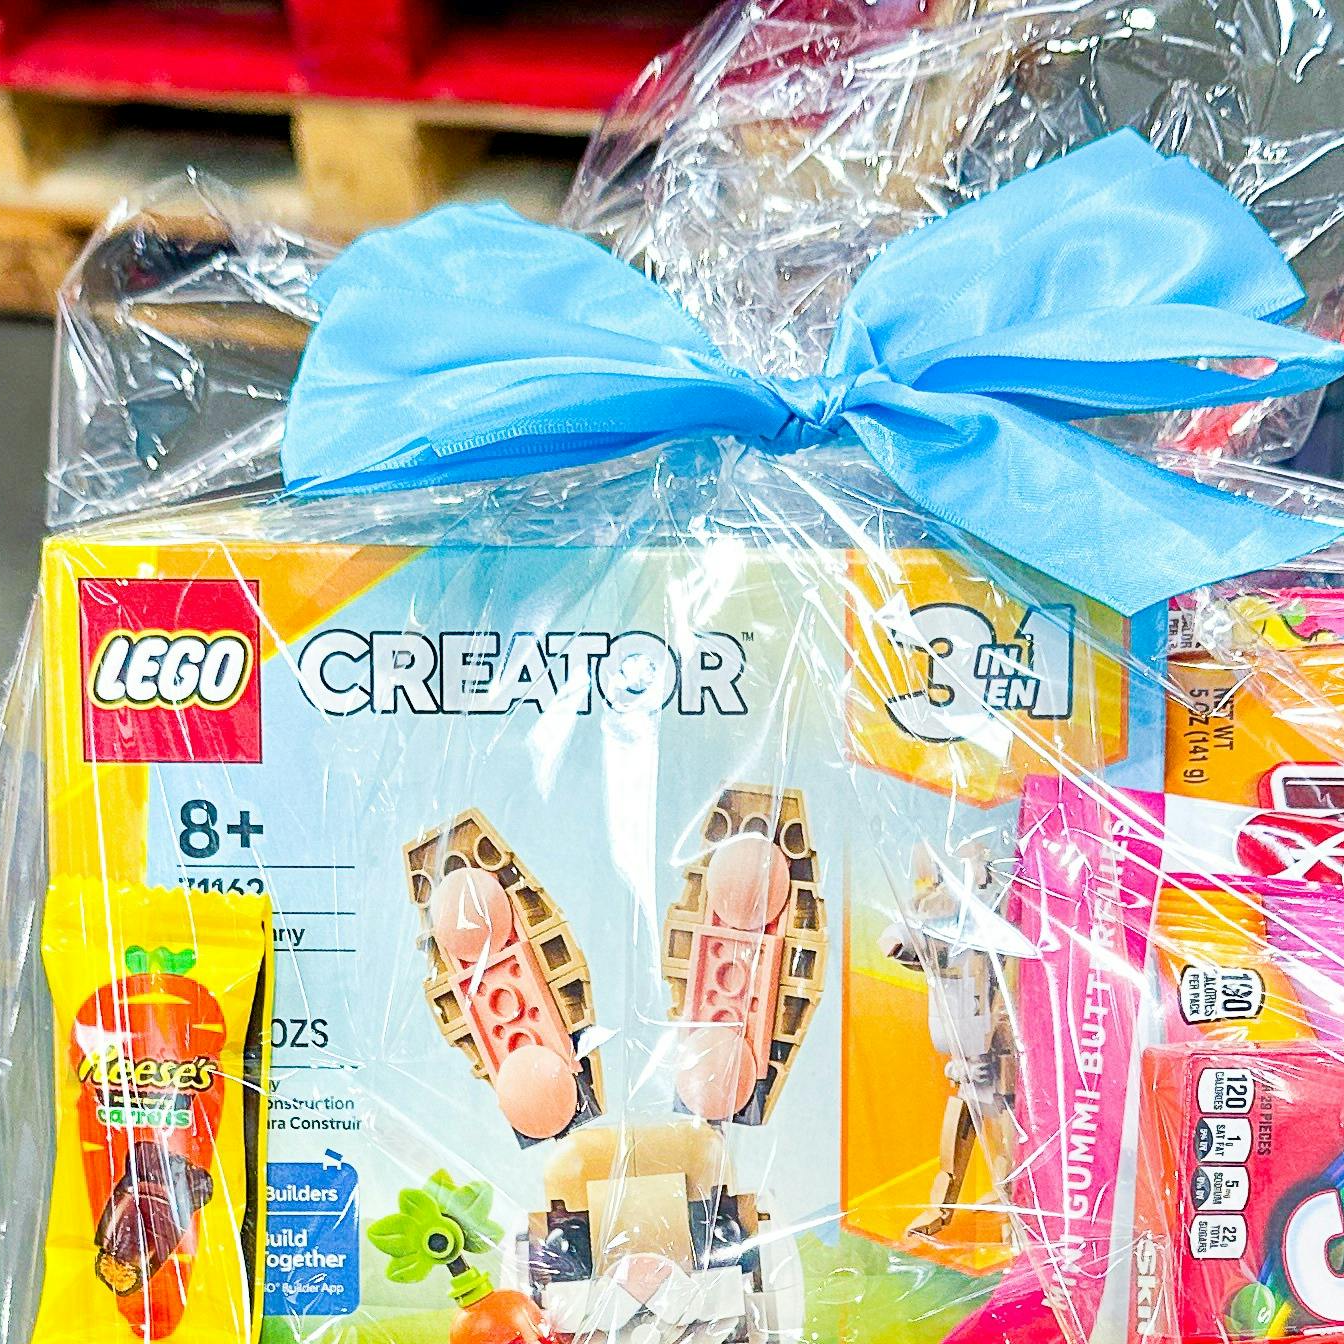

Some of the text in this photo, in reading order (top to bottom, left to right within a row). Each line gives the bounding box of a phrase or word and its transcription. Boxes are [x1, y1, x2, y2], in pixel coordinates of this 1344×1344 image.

[92, 632, 252, 705] LEGO
[298, 629, 749, 716] CREATOR
[1190, 688, 1207, 698] 5
[1213, 725, 1234, 750] WT
[180, 799, 263, 858] 8+
[1214, 1072, 1224, 1110] CALORIES
[1226, 1075, 1248, 1108] 120
[290, 1117, 362, 1130] Construir
[1257, 1114, 1272, 1155] PIECES
[1065, 1089, 1102, 1220] GUMMI
[1215, 1124, 1225, 1156] SAT FAT
[1213, 1172, 1223, 1205] SODIUM
[265, 1229, 307, 1247] uild
[1197, 1221, 1208, 1252] SUGARS
[1209, 1225, 1221, 1248] TOTAL
[265, 1249, 346, 1272] ogether
